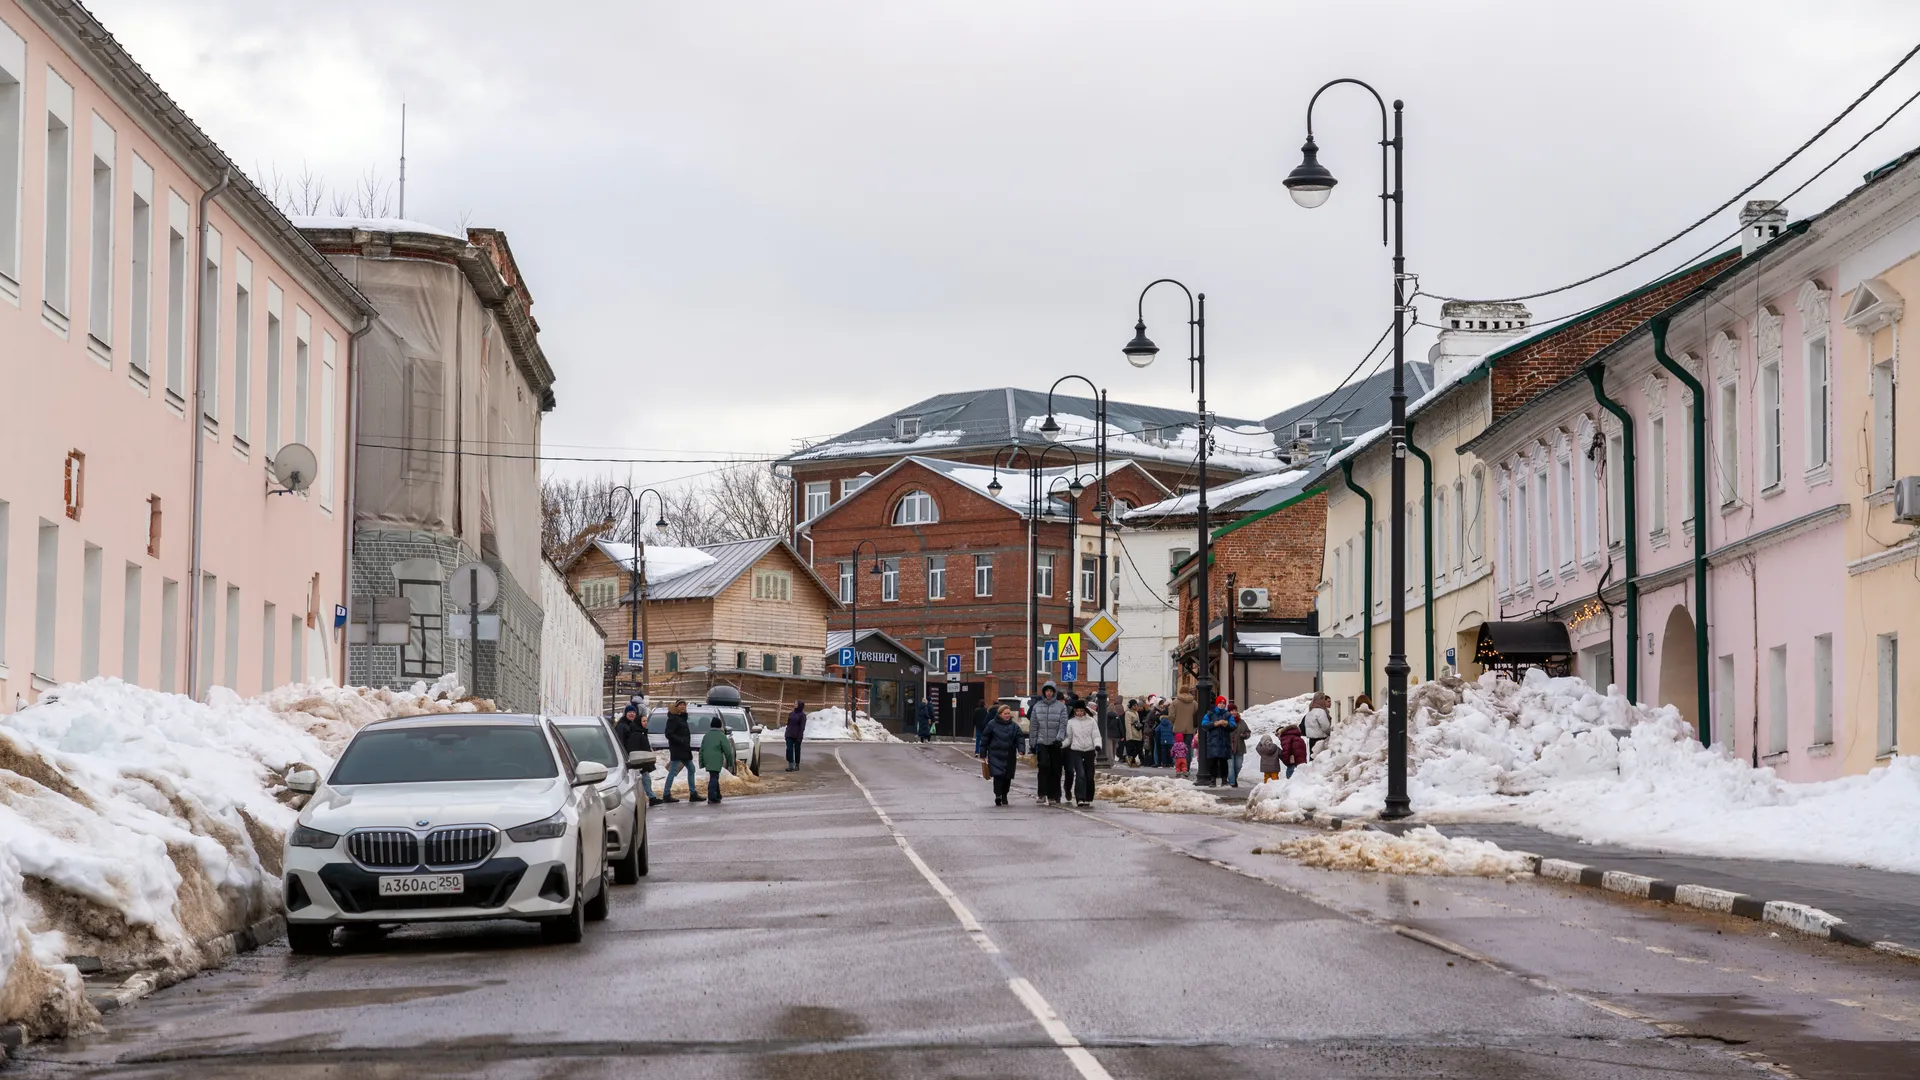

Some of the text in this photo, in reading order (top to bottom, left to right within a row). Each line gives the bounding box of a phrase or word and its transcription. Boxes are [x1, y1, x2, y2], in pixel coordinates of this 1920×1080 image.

[632, 642, 641, 658] P
[842, 649, 852, 665] P
[855, 651, 898, 663] УВЕНИРЫ
[949, 656, 958, 671] P
[384, 876, 459, 893] А360АС 250
